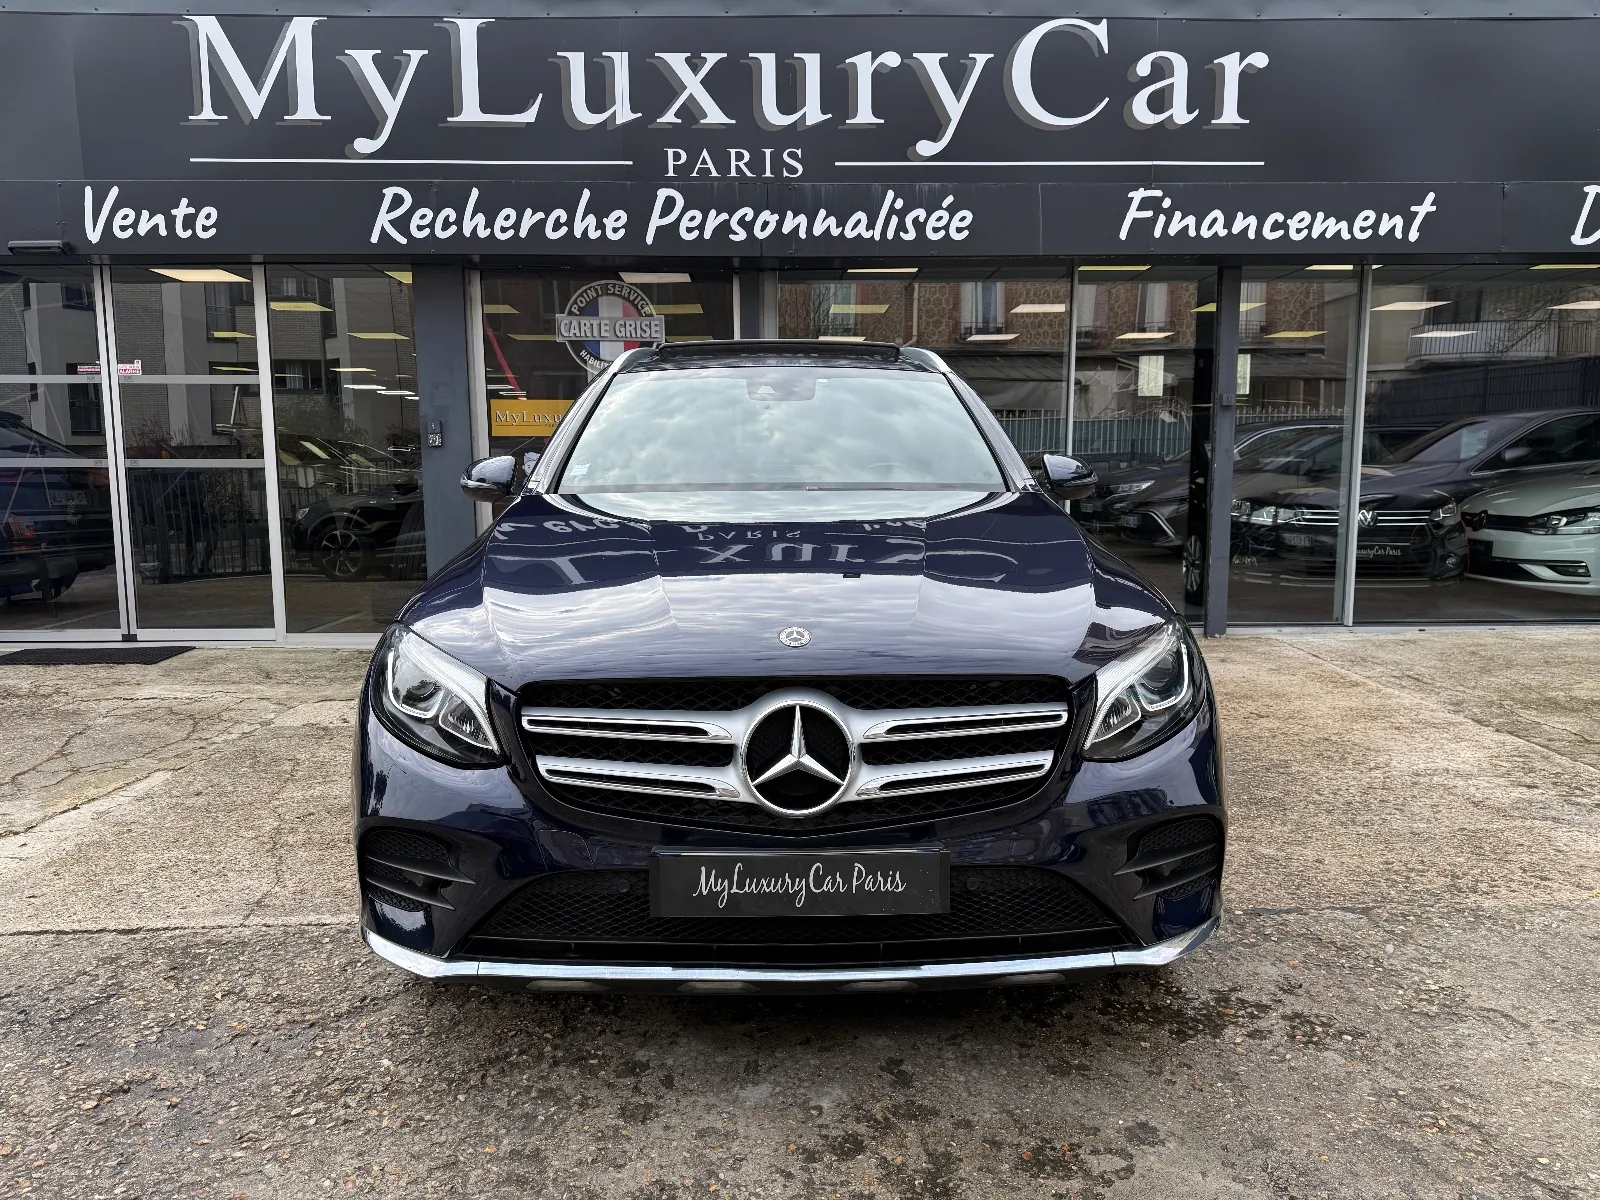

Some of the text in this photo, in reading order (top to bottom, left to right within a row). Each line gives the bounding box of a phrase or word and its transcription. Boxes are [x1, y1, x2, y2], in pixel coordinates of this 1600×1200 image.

[183, 16, 1269, 157] MyLuxuryCar
[664, 147, 804, 178] PARIS
[84, 185, 218, 245] Vente
[369, 186, 974, 246] Recherche Personnalisée
[1118, 187, 1437, 243] Financement
[571, 284, 652, 316] POINT SERVICE
[560, 320, 661, 338] CARTE GRISE
[580, 350, 611, 369] HABILIT
[495, 411, 562, 425] MyLuxu
[692, 862, 907, 909] MyLuxuryCar Paris
